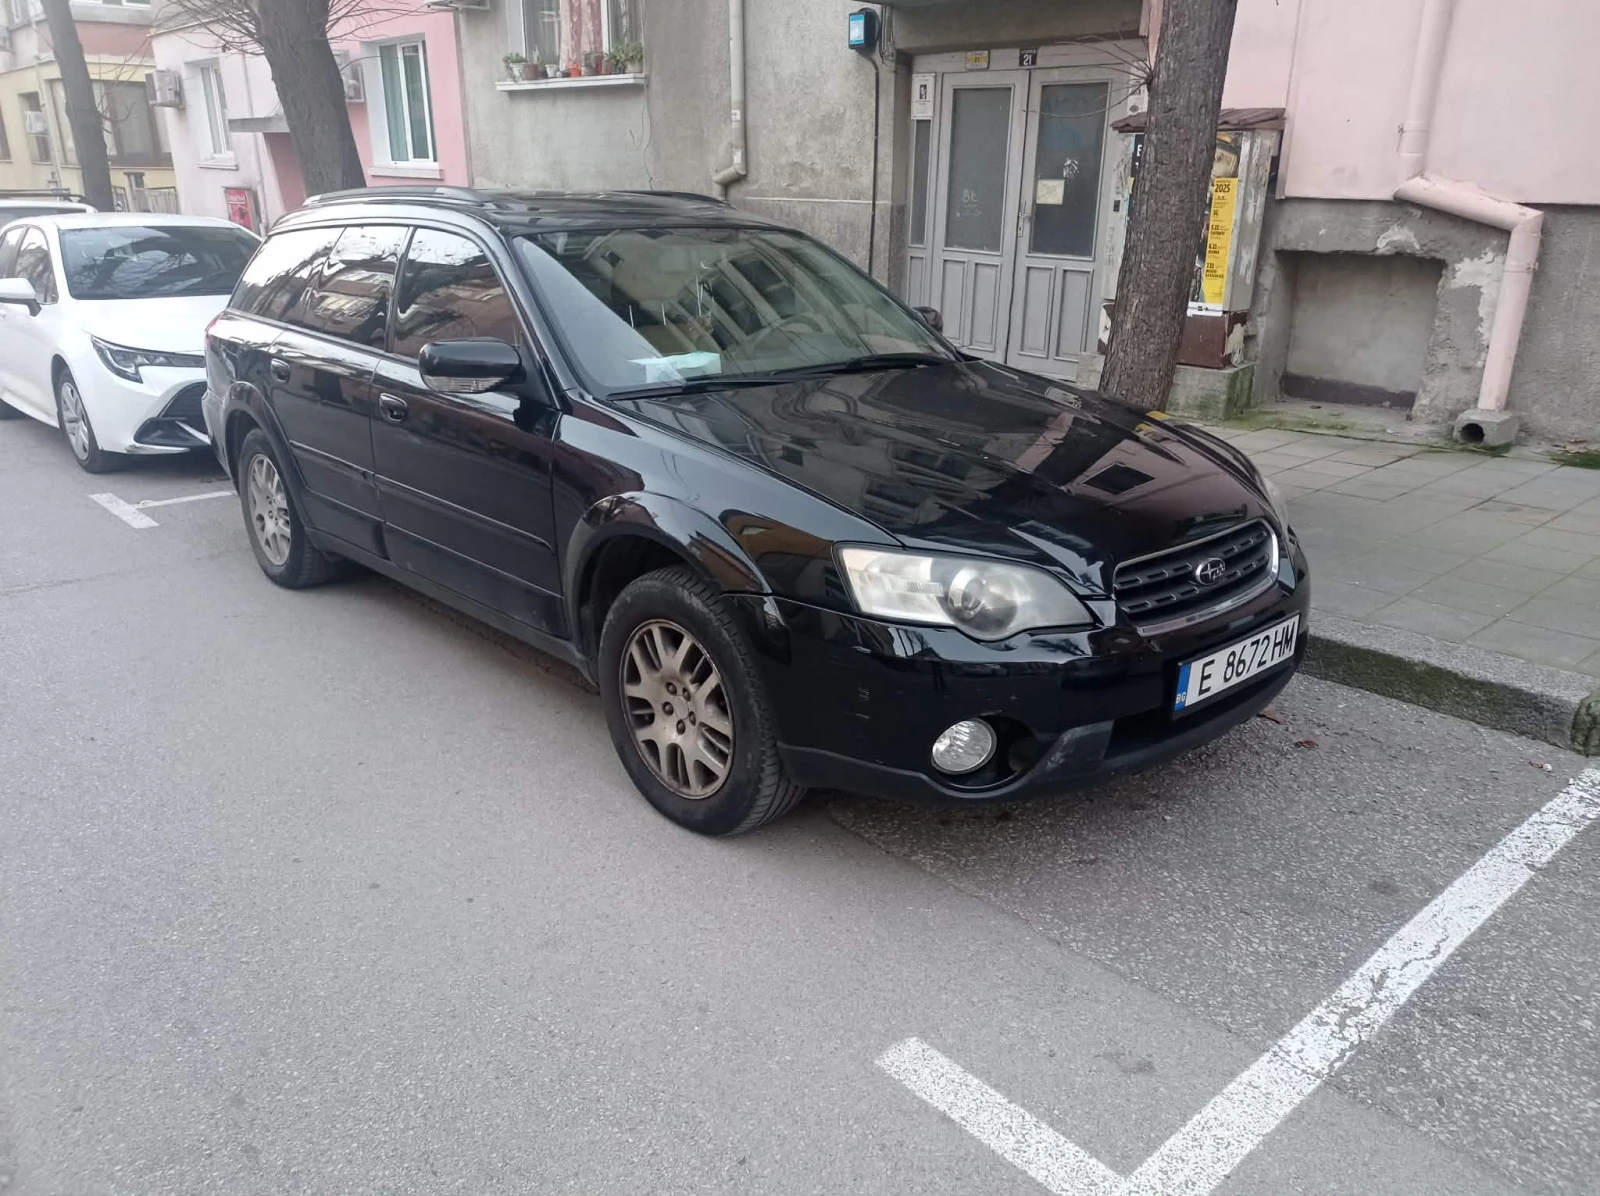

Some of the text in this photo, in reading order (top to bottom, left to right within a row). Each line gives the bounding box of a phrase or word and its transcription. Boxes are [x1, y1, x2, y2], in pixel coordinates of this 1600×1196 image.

[1023, 54, 1032, 66] 21
[1214, 184, 1231, 193] 2025
[1198, 659, 1215, 696] E
[1223, 634, 1270, 683] 8672
[1175, 692, 1187, 704] BG
